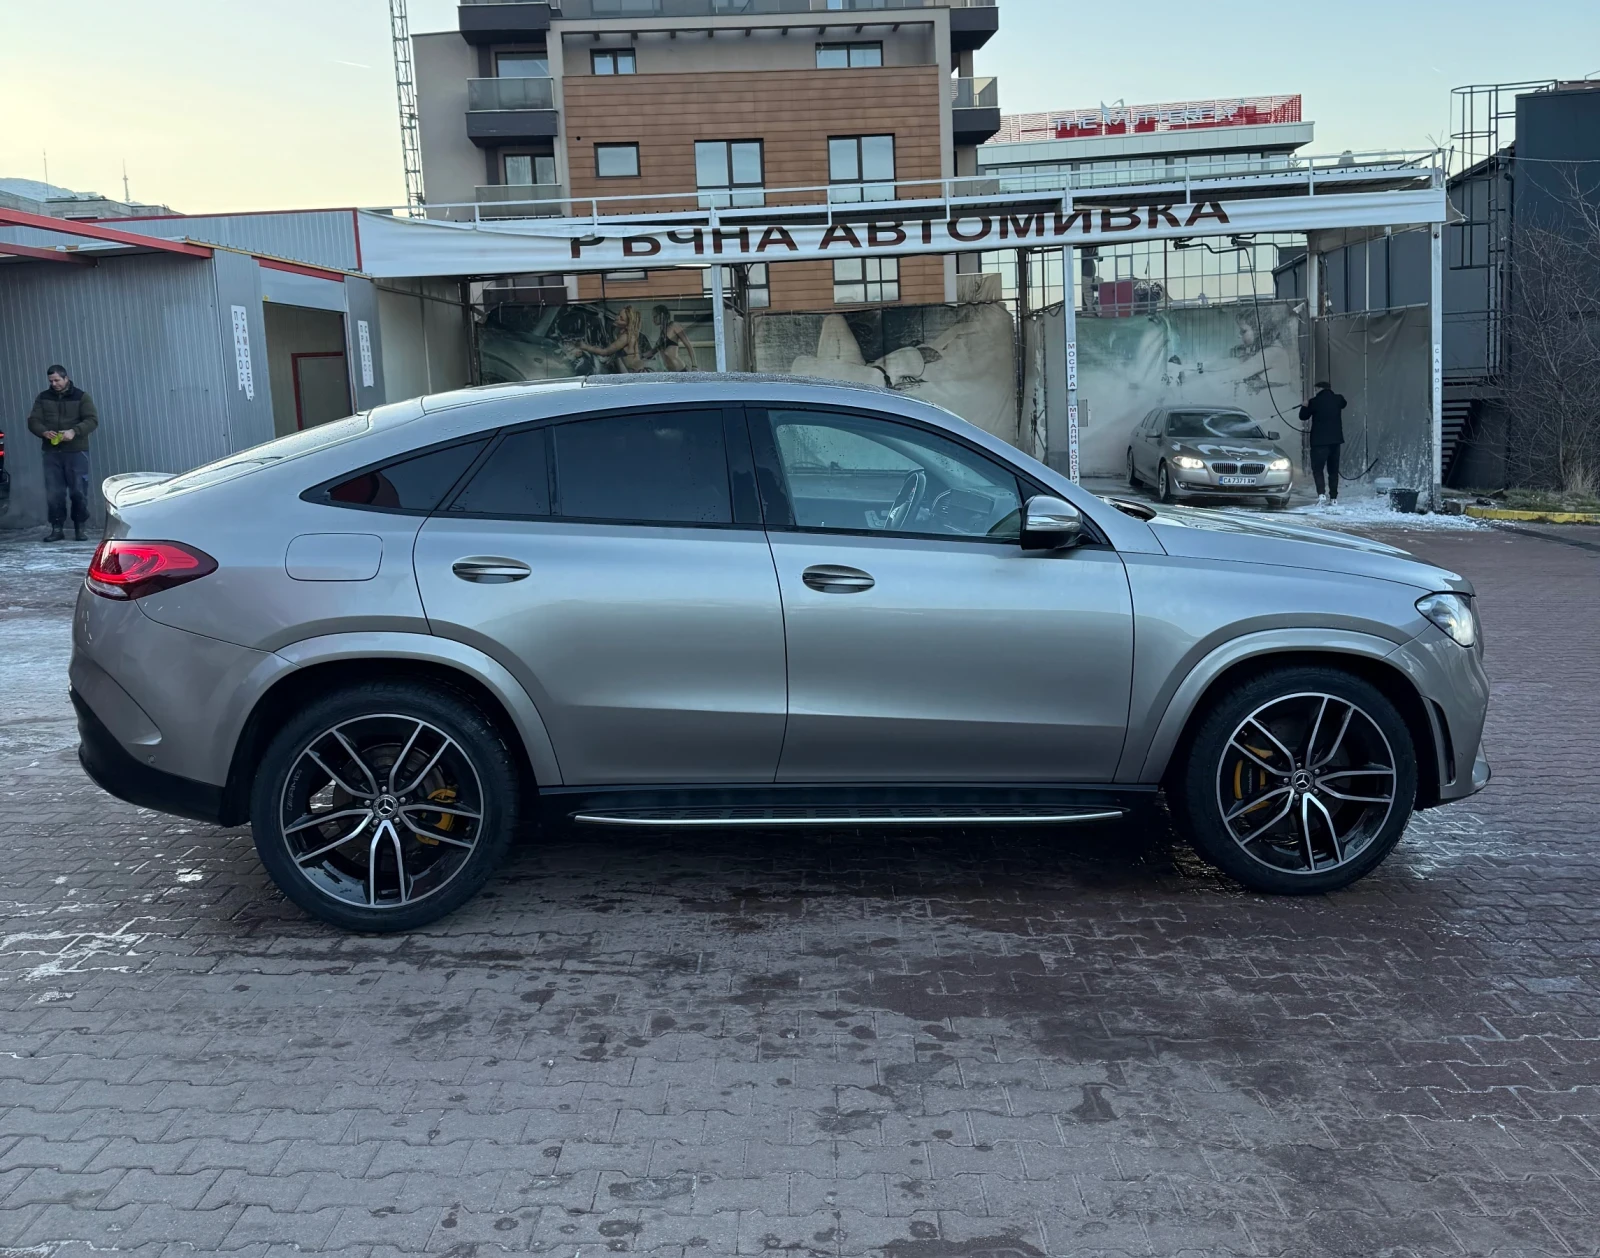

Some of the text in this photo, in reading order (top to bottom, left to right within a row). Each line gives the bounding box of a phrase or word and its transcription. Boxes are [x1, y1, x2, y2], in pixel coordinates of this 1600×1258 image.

[1053, 115, 1098, 131] THE
[818, 201, 1231, 250] АВТОМИВКА
[1067, 343, 1076, 388] МОСТРА
